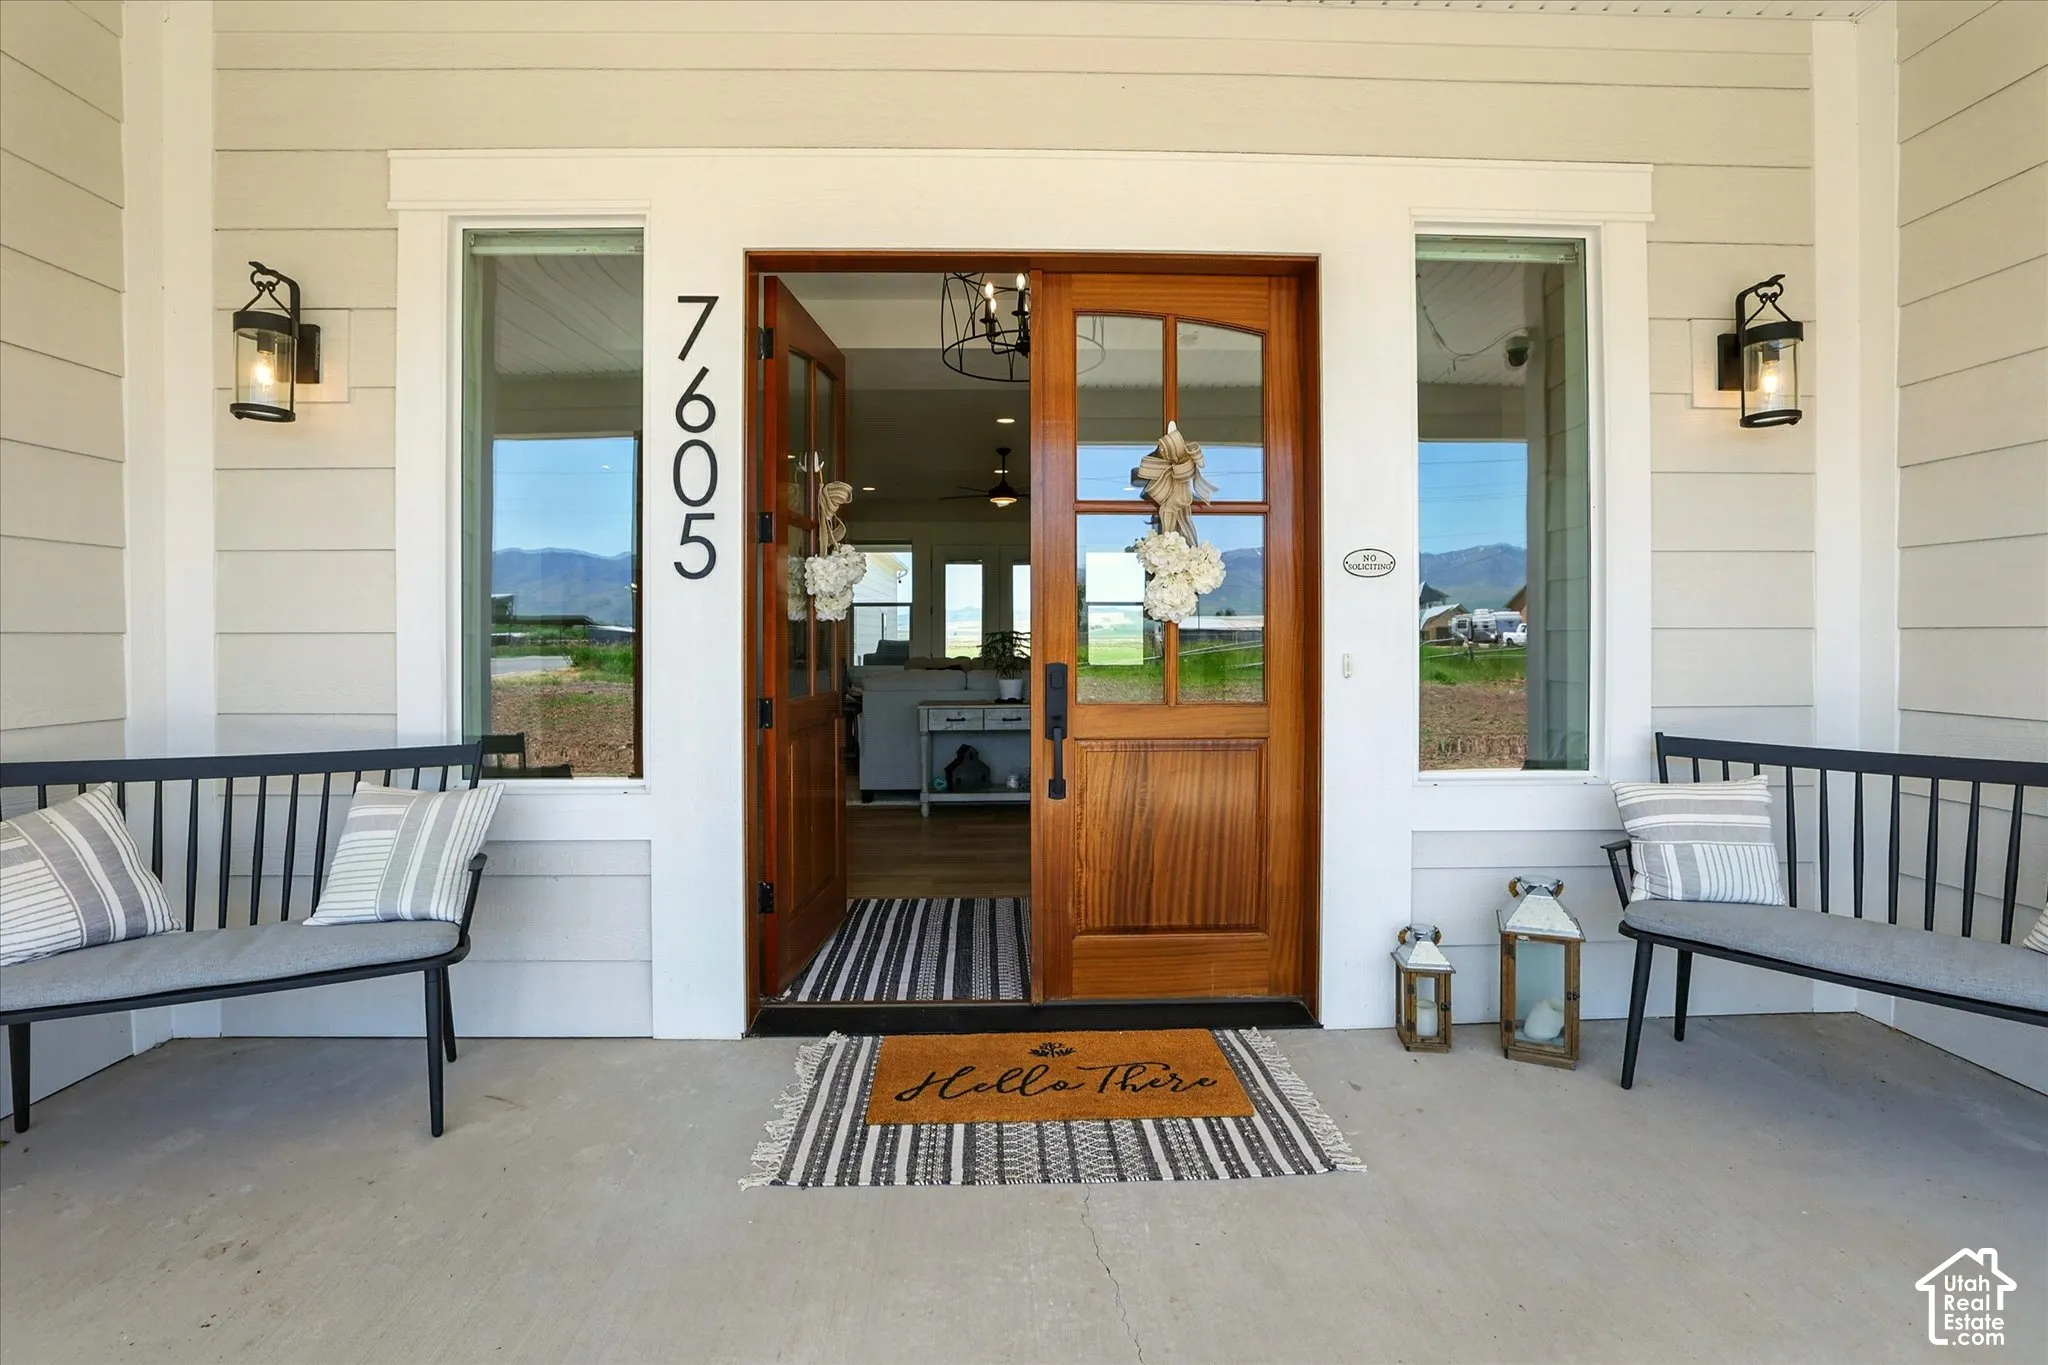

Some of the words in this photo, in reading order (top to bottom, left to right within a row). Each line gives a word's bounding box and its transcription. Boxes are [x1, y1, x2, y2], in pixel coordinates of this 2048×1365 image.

[673, 295, 719, 580] 7605
[1348, 563, 1391, 571] SOLICITING
[1363, 554, 1377, 562] NO
[894, 1064, 1084, 1101] Hello
[1076, 1061, 1218, 1095] There
